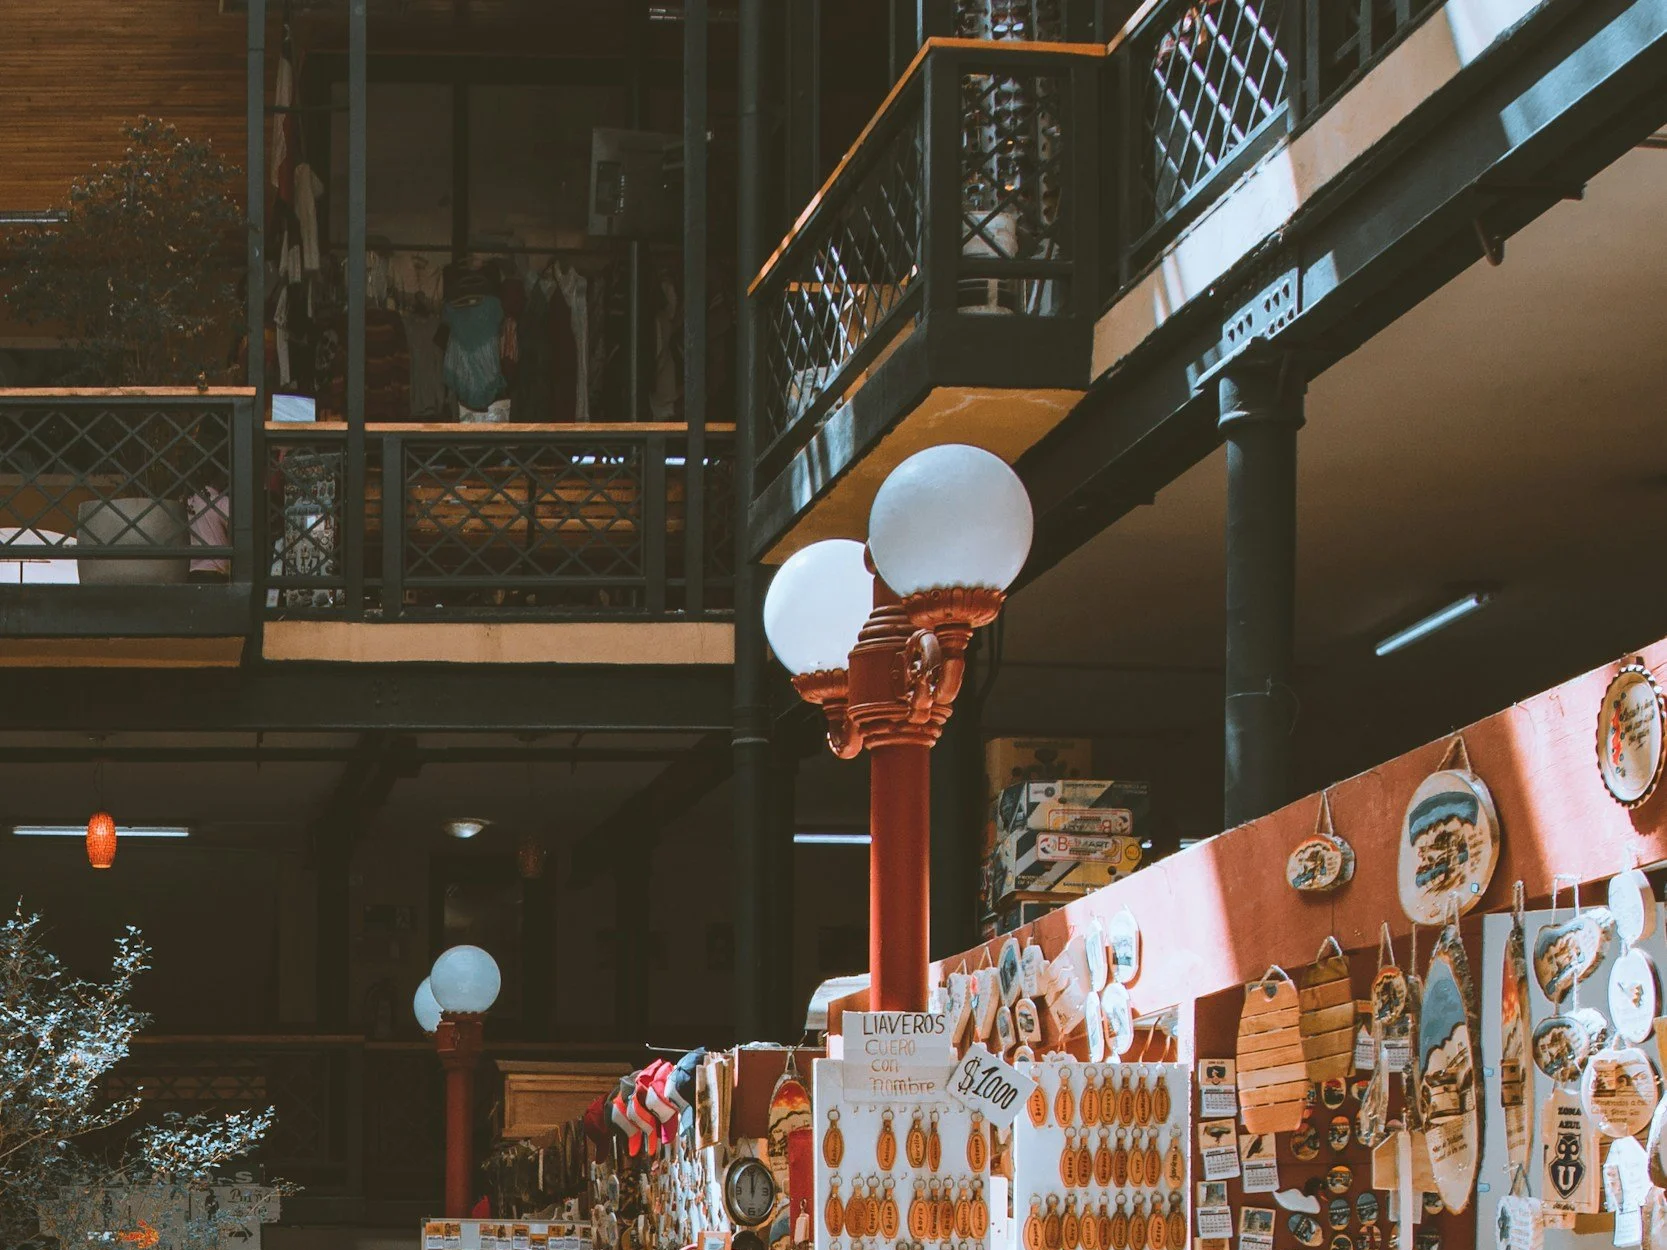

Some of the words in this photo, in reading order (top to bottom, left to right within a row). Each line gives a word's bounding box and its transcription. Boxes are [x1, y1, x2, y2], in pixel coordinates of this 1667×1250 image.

[866, 1040, 916, 1056] CUERO
[1558, 1107, 1582, 1116] ZONA
[1558, 1120, 1581, 1130] AZUL
[762, 1188, 770, 1196] 3
[748, 1208, 756, 1216] 6
